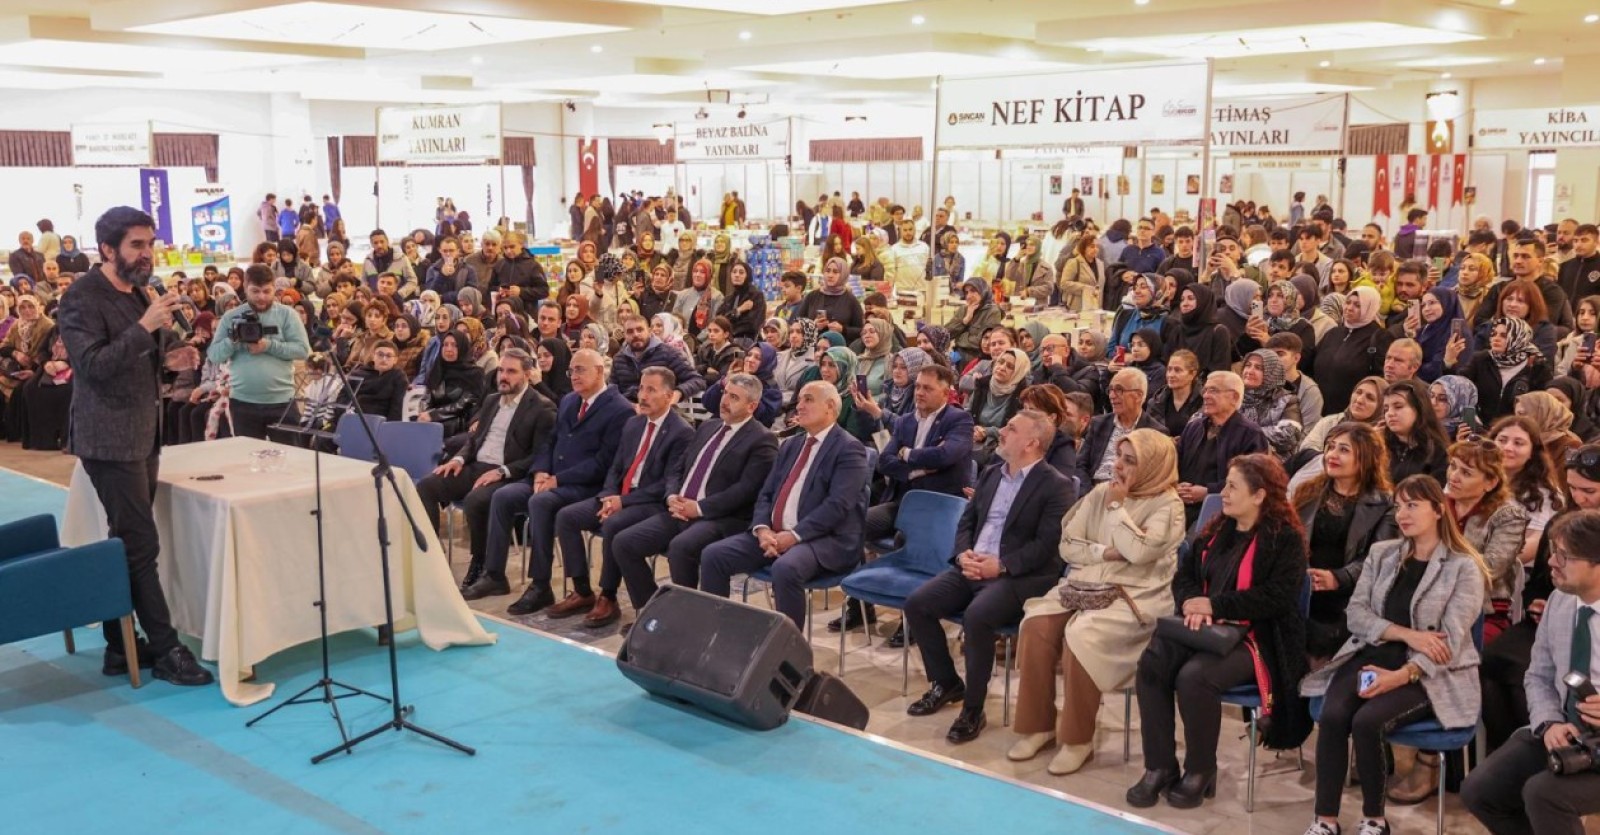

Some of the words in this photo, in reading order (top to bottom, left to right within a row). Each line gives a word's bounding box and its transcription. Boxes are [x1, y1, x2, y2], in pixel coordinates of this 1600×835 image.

[992, 99, 1045, 126] NEF
[1053, 90, 1146, 123] KİTAP
[1215, 104, 1272, 124] TİMAŞ
[1548, 109, 1587, 124] KİBA
[412, 113, 461, 130] KUMRAN
[696, 126, 728, 139] BEYAZ
[730, 124, 768, 138] BALİNA
[1210, 129, 1289, 146] AYINLARI
[1519, 130, 1600, 144] YAYINCIL
[409, 136, 465, 153] YAYINLARI
[704, 144, 760, 156] YAYINLARI
